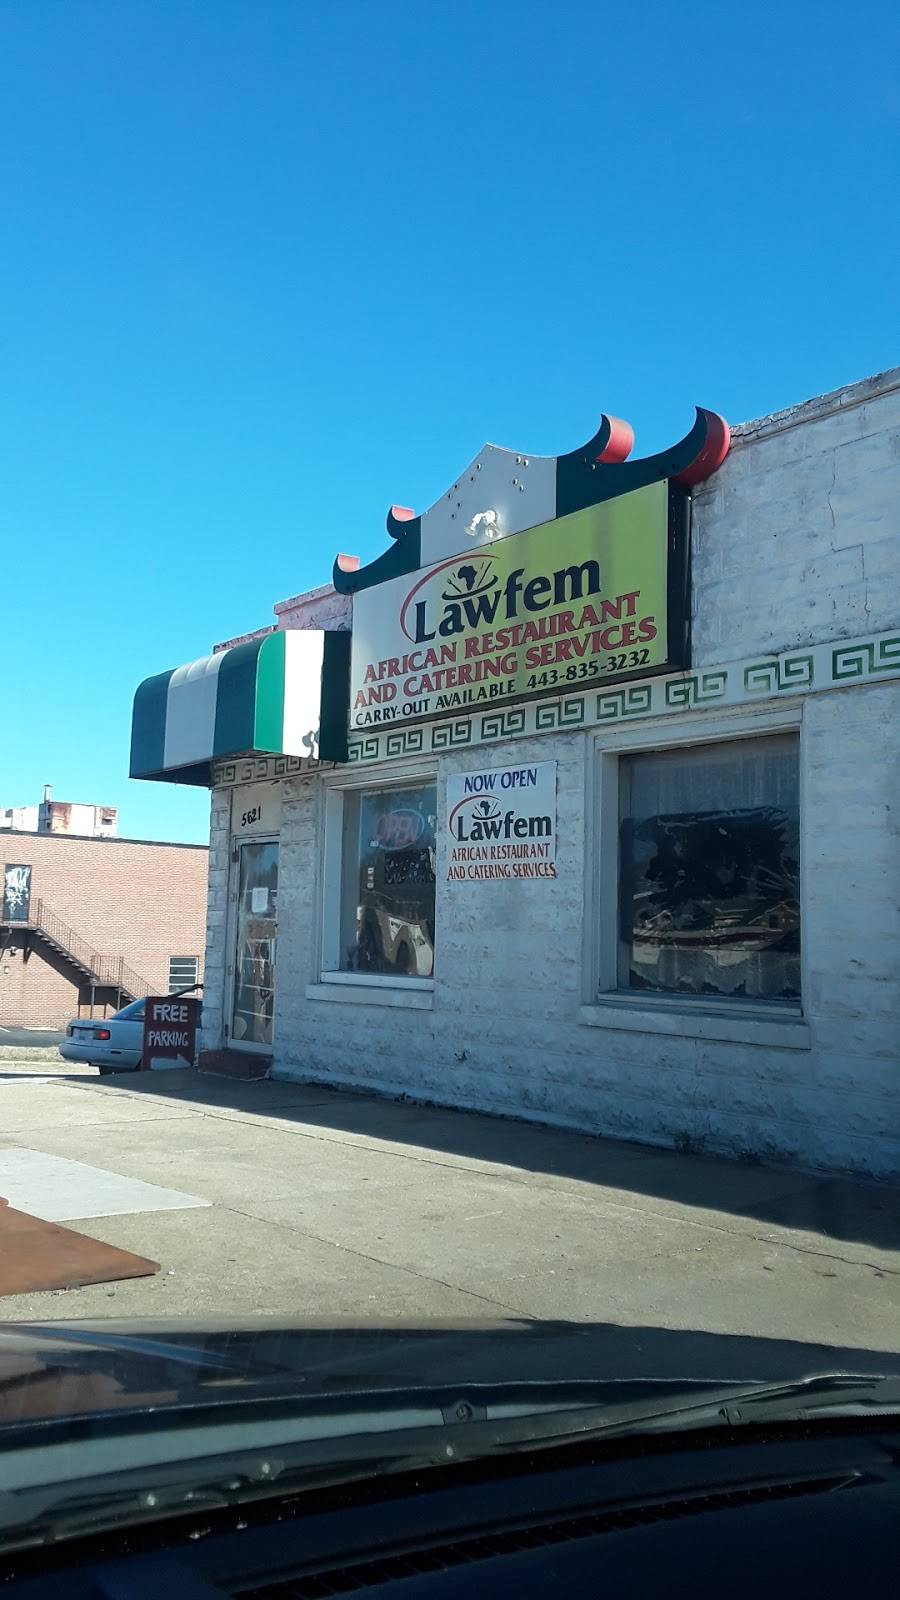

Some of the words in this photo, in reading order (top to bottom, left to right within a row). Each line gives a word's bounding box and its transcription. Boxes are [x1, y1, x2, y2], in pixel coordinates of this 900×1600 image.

[414, 559, 602, 644] Lawfem
[363, 641, 457, 684] AFRICAN
[464, 590, 640, 659] RESTAURANT
[353, 679, 397, 709] AND
[403, 652, 517, 697] CATERING
[525, 616, 657, 669] SERVICES
[355, 698, 429, 726] CARRY-OUT
[435, 679, 516, 710] AVAILABLE
[526, 648, 650, 689] 443-835-3232
[464, 773, 497, 793] NOW
[500, 768, 537, 789] OPEN
[241, 806, 261, 827] 5621
[457, 810, 552, 842] Lawfem
[452, 846, 488, 862] AFRICAN
[490, 843, 550, 860] RESTAURANT
[447, 865, 466, 880] AND
[468, 863, 511, 880] CATERING
[512, 862, 557, 879] SERVICES
[153, 1004, 189, 1023] FREE
[148, 1030, 189, 1047] PARKING
